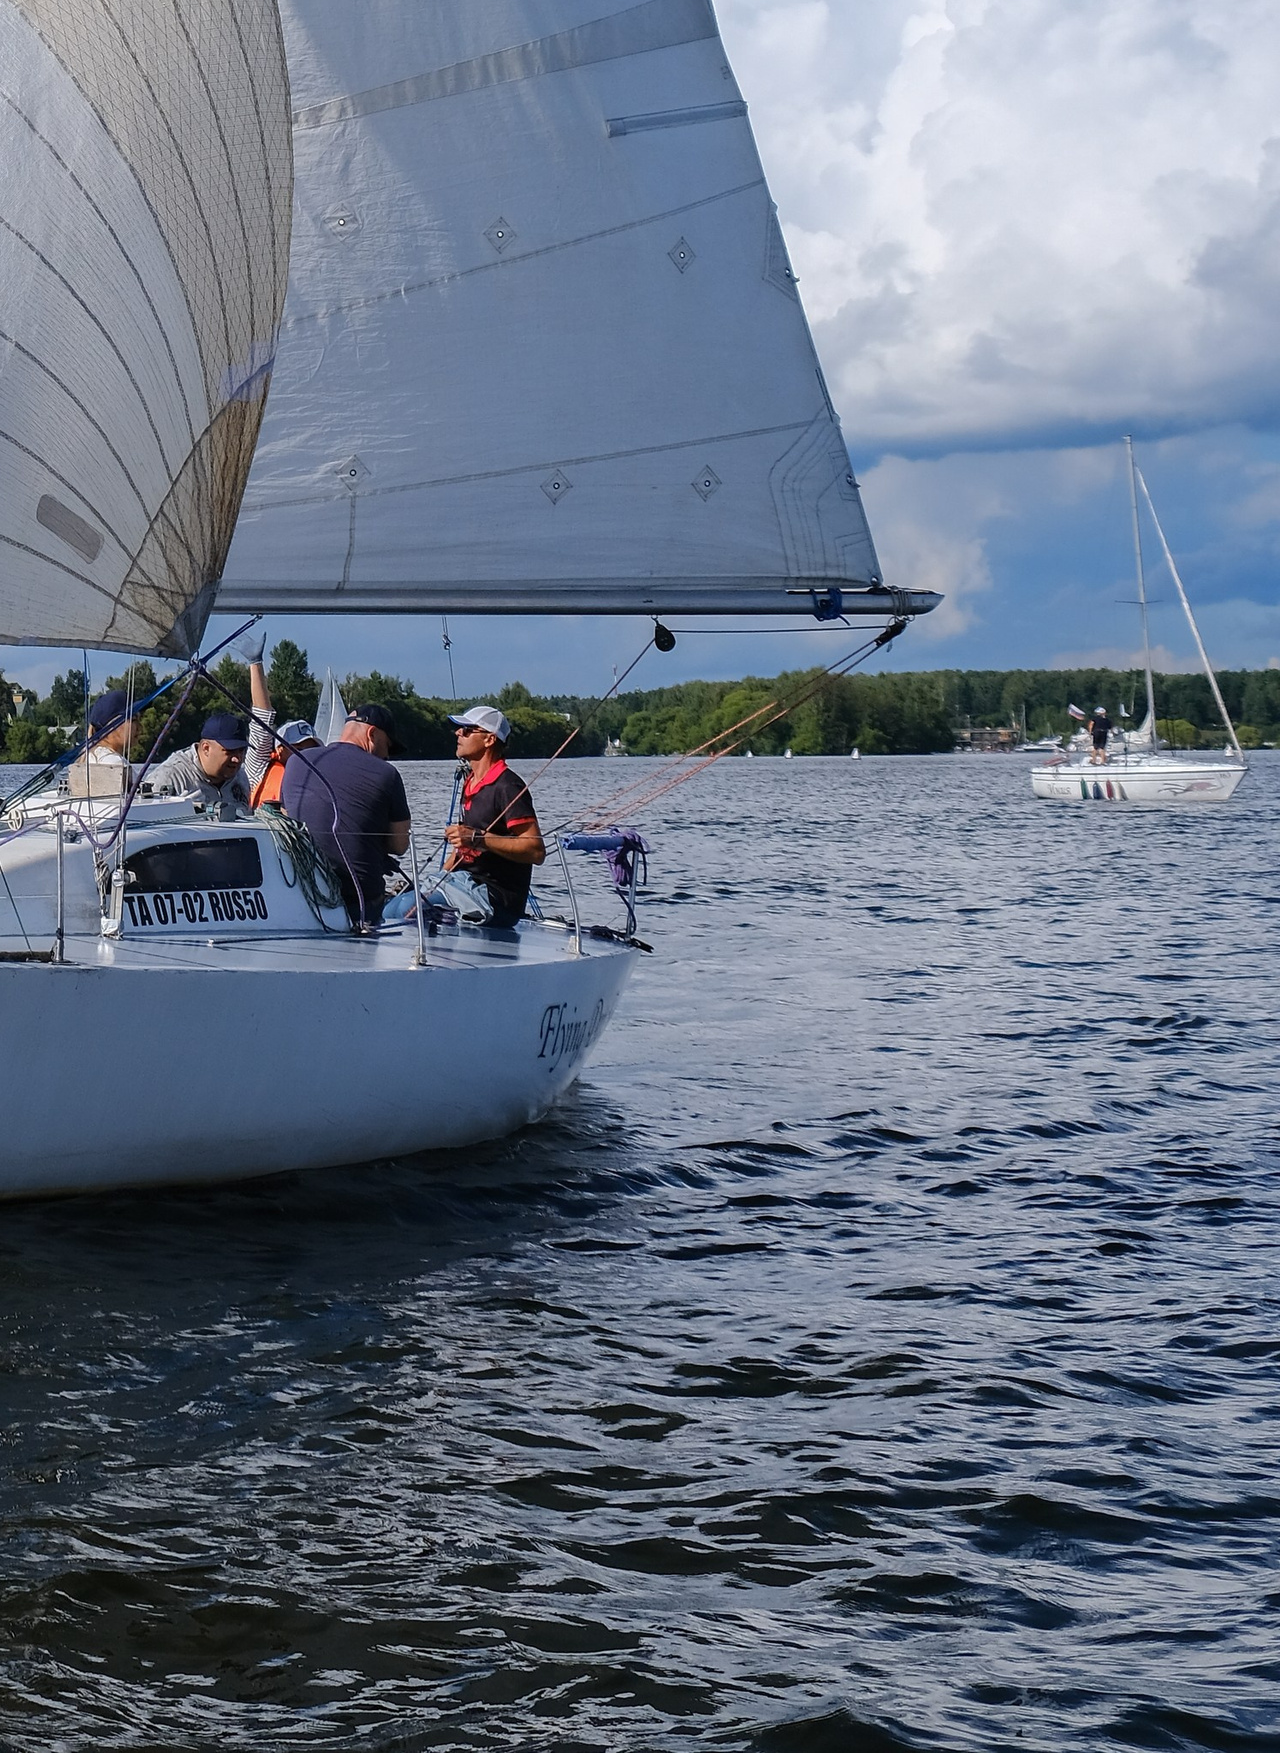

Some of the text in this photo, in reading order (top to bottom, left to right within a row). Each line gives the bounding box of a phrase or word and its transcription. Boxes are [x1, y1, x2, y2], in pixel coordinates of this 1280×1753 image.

[124, 890, 269, 927] TA 07-02 RUS50
